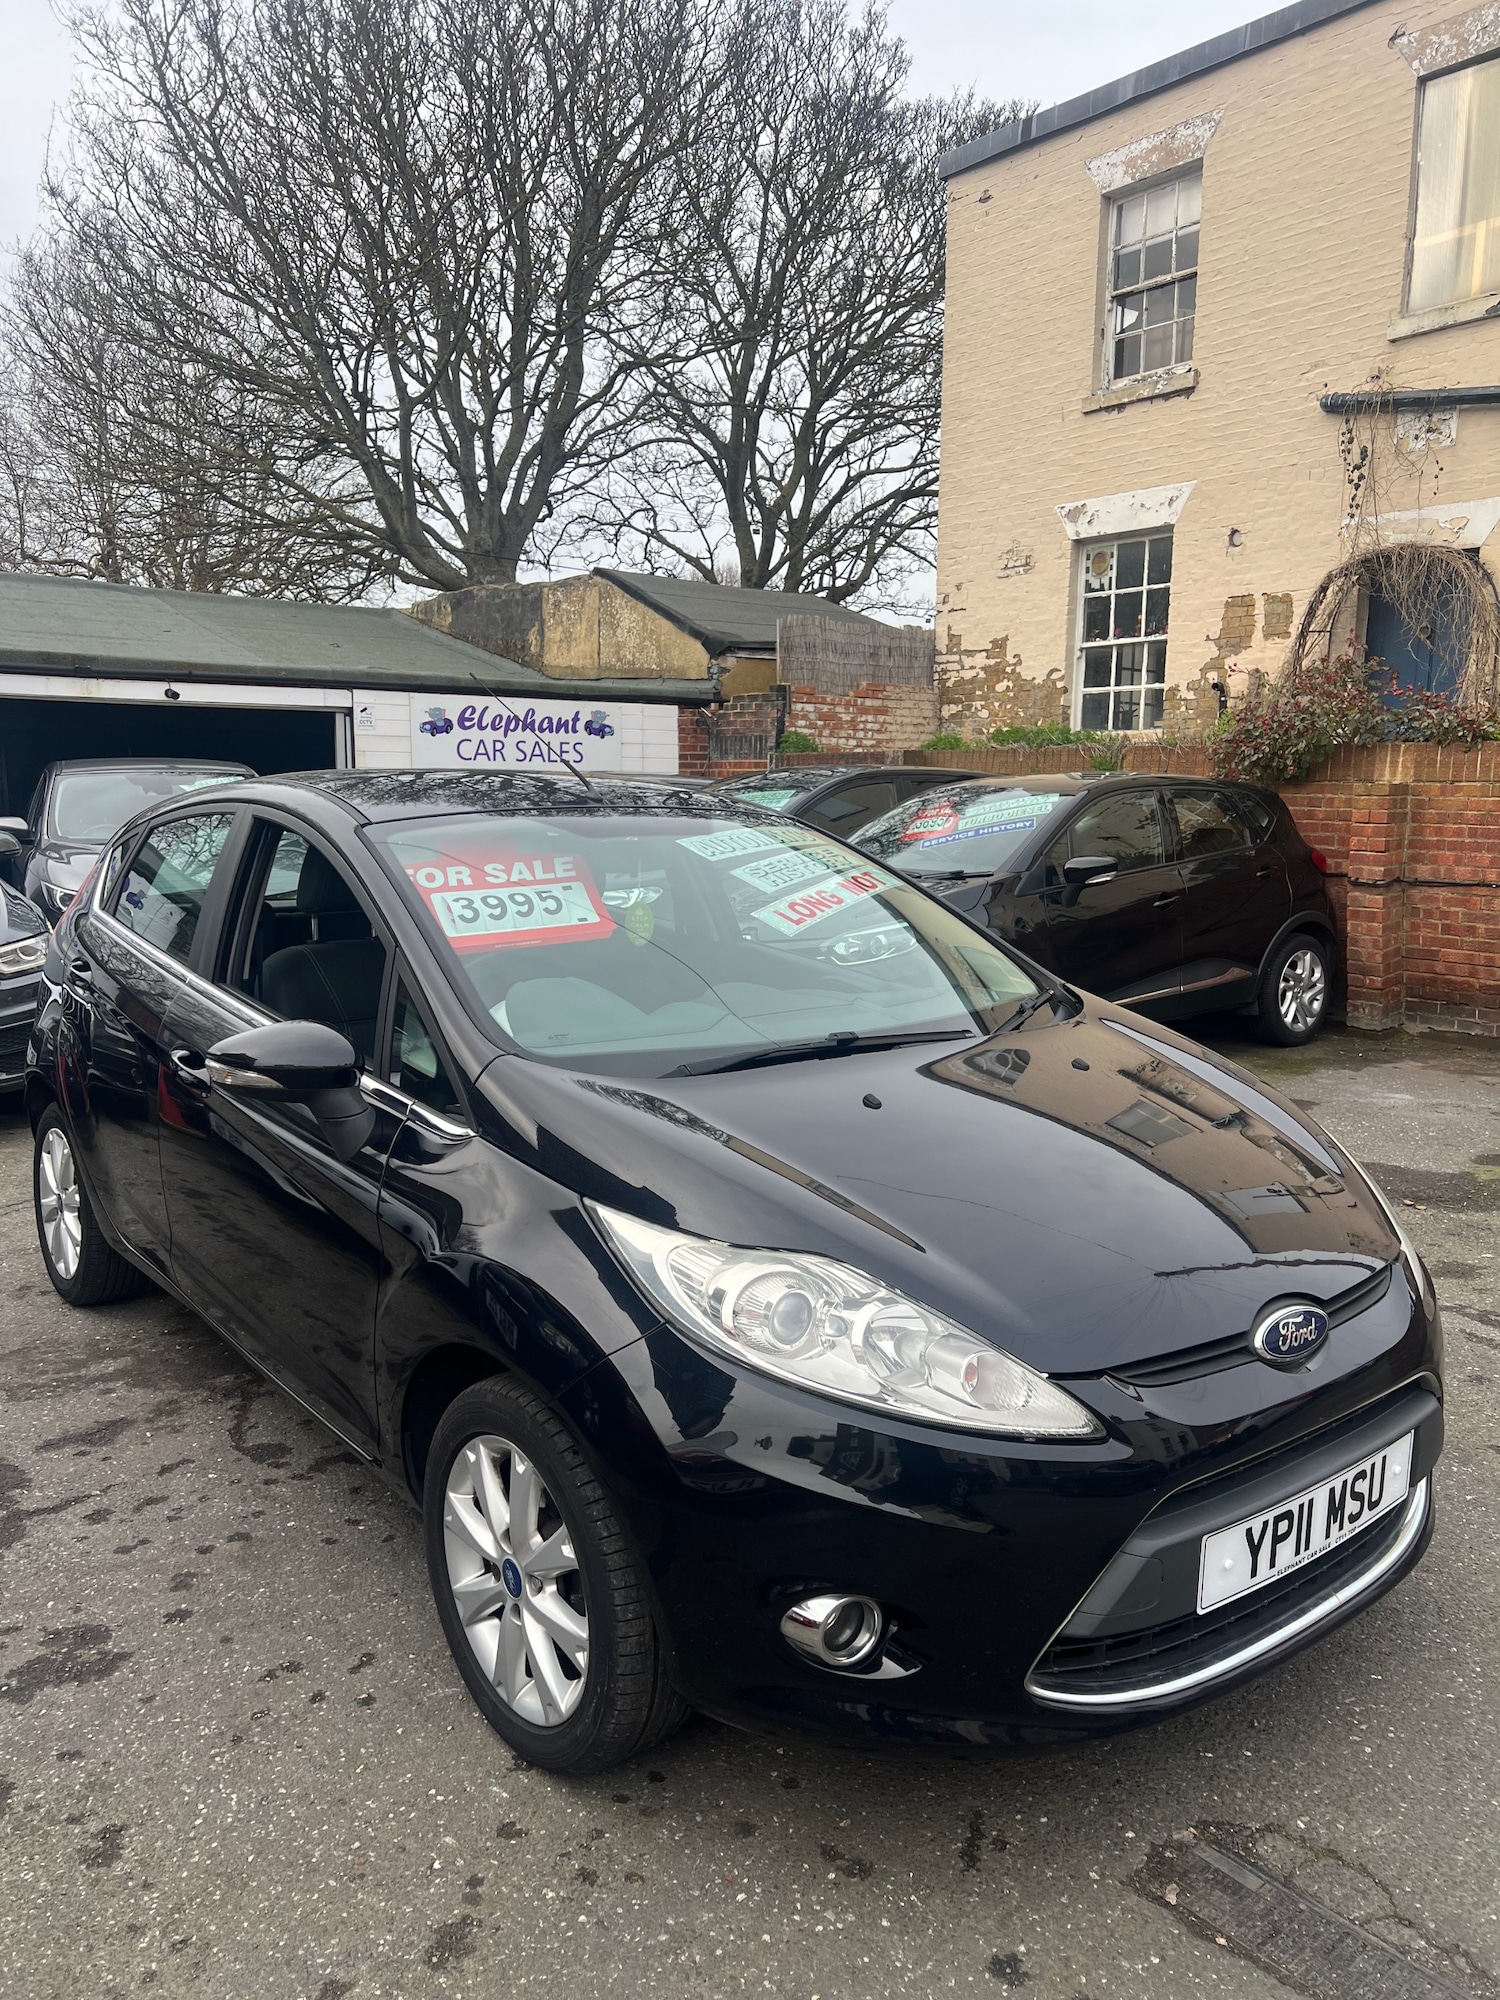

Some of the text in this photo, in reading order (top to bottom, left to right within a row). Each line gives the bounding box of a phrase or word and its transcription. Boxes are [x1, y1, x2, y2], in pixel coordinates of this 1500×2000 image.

[457, 705, 581, 738] Elephant
[456, 738, 584, 763] CAR SALES
[923, 819, 1033, 847] SERVICE HISTORY
[484, 856, 577, 884] SALE
[451, 889, 563, 924] 3995
[773, 871, 887, 926] LONG MOT
[1278, 1313, 1318, 1352] Ford
[1245, 1455, 1387, 1579] YP11 MSU
[1276, 1557, 1306, 1576] ELEPHANT
[1306, 1551, 1318, 1561] CAR
